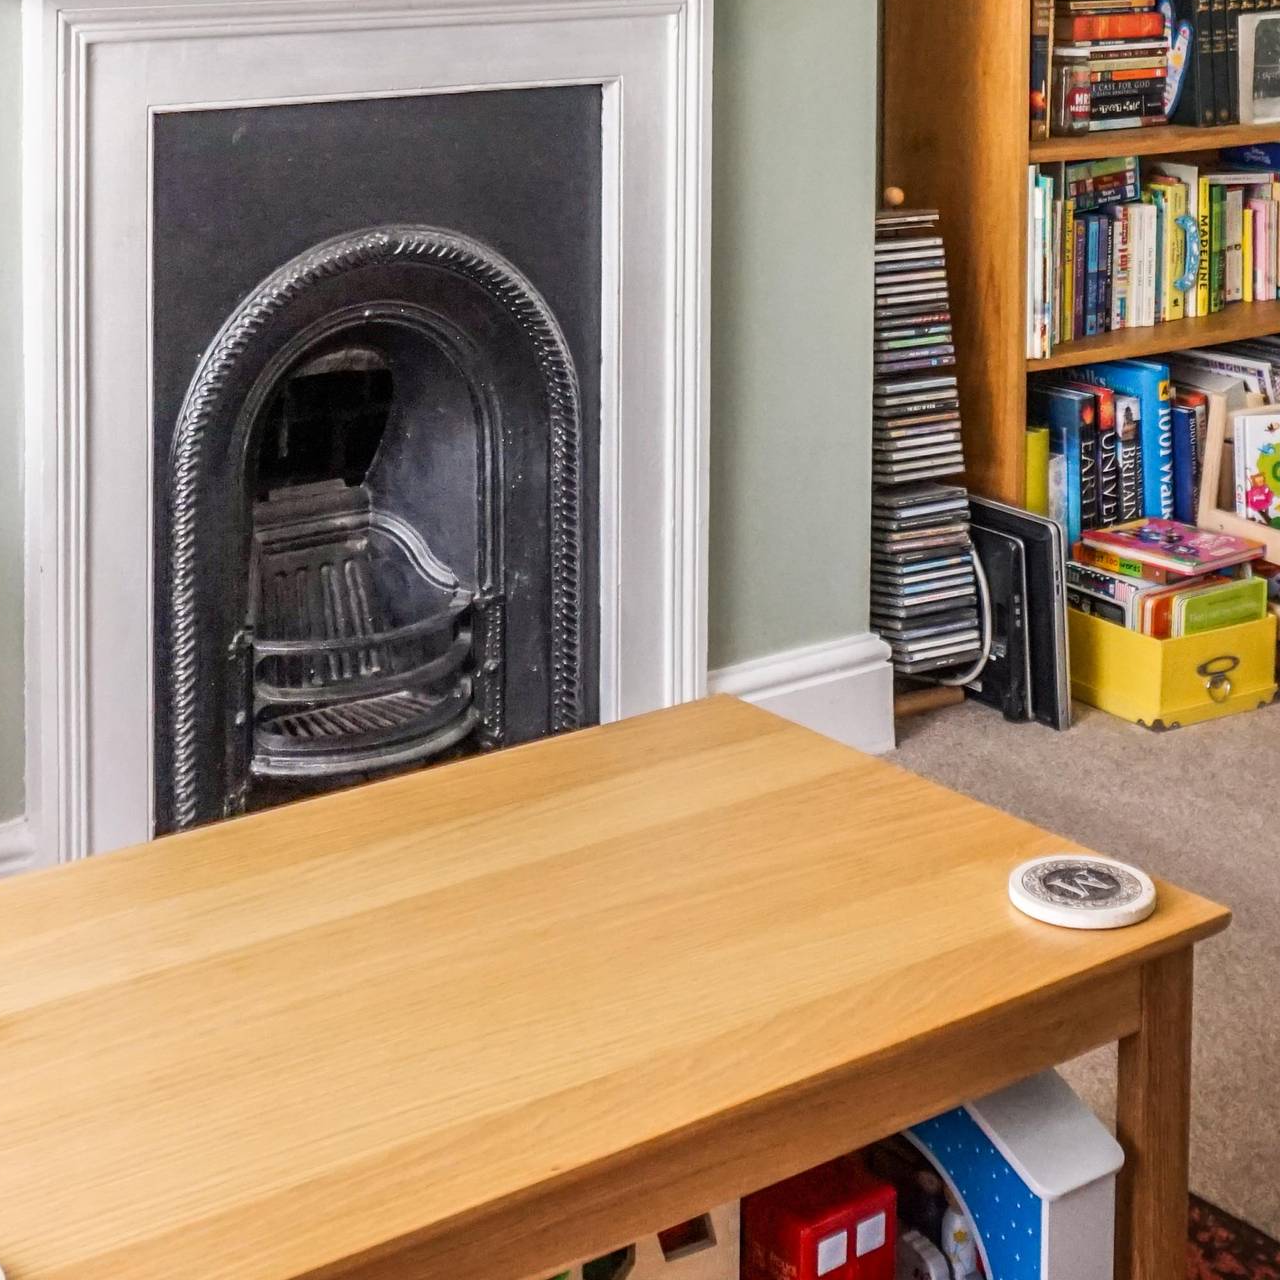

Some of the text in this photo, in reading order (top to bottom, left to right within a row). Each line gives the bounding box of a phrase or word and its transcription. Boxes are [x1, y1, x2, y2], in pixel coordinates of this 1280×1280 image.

[1118, 82, 1133, 90] FOR
[1134, 80, 1151, 88] GOD
[1199, 214, 1209, 291] MADELINE
[1101, 431, 1117, 527] UNIVE
[1121, 445, 1137, 520] BRITAIN
[1158, 407, 1173, 520] 1001 Walk
[1120, 561, 1141, 573] words
